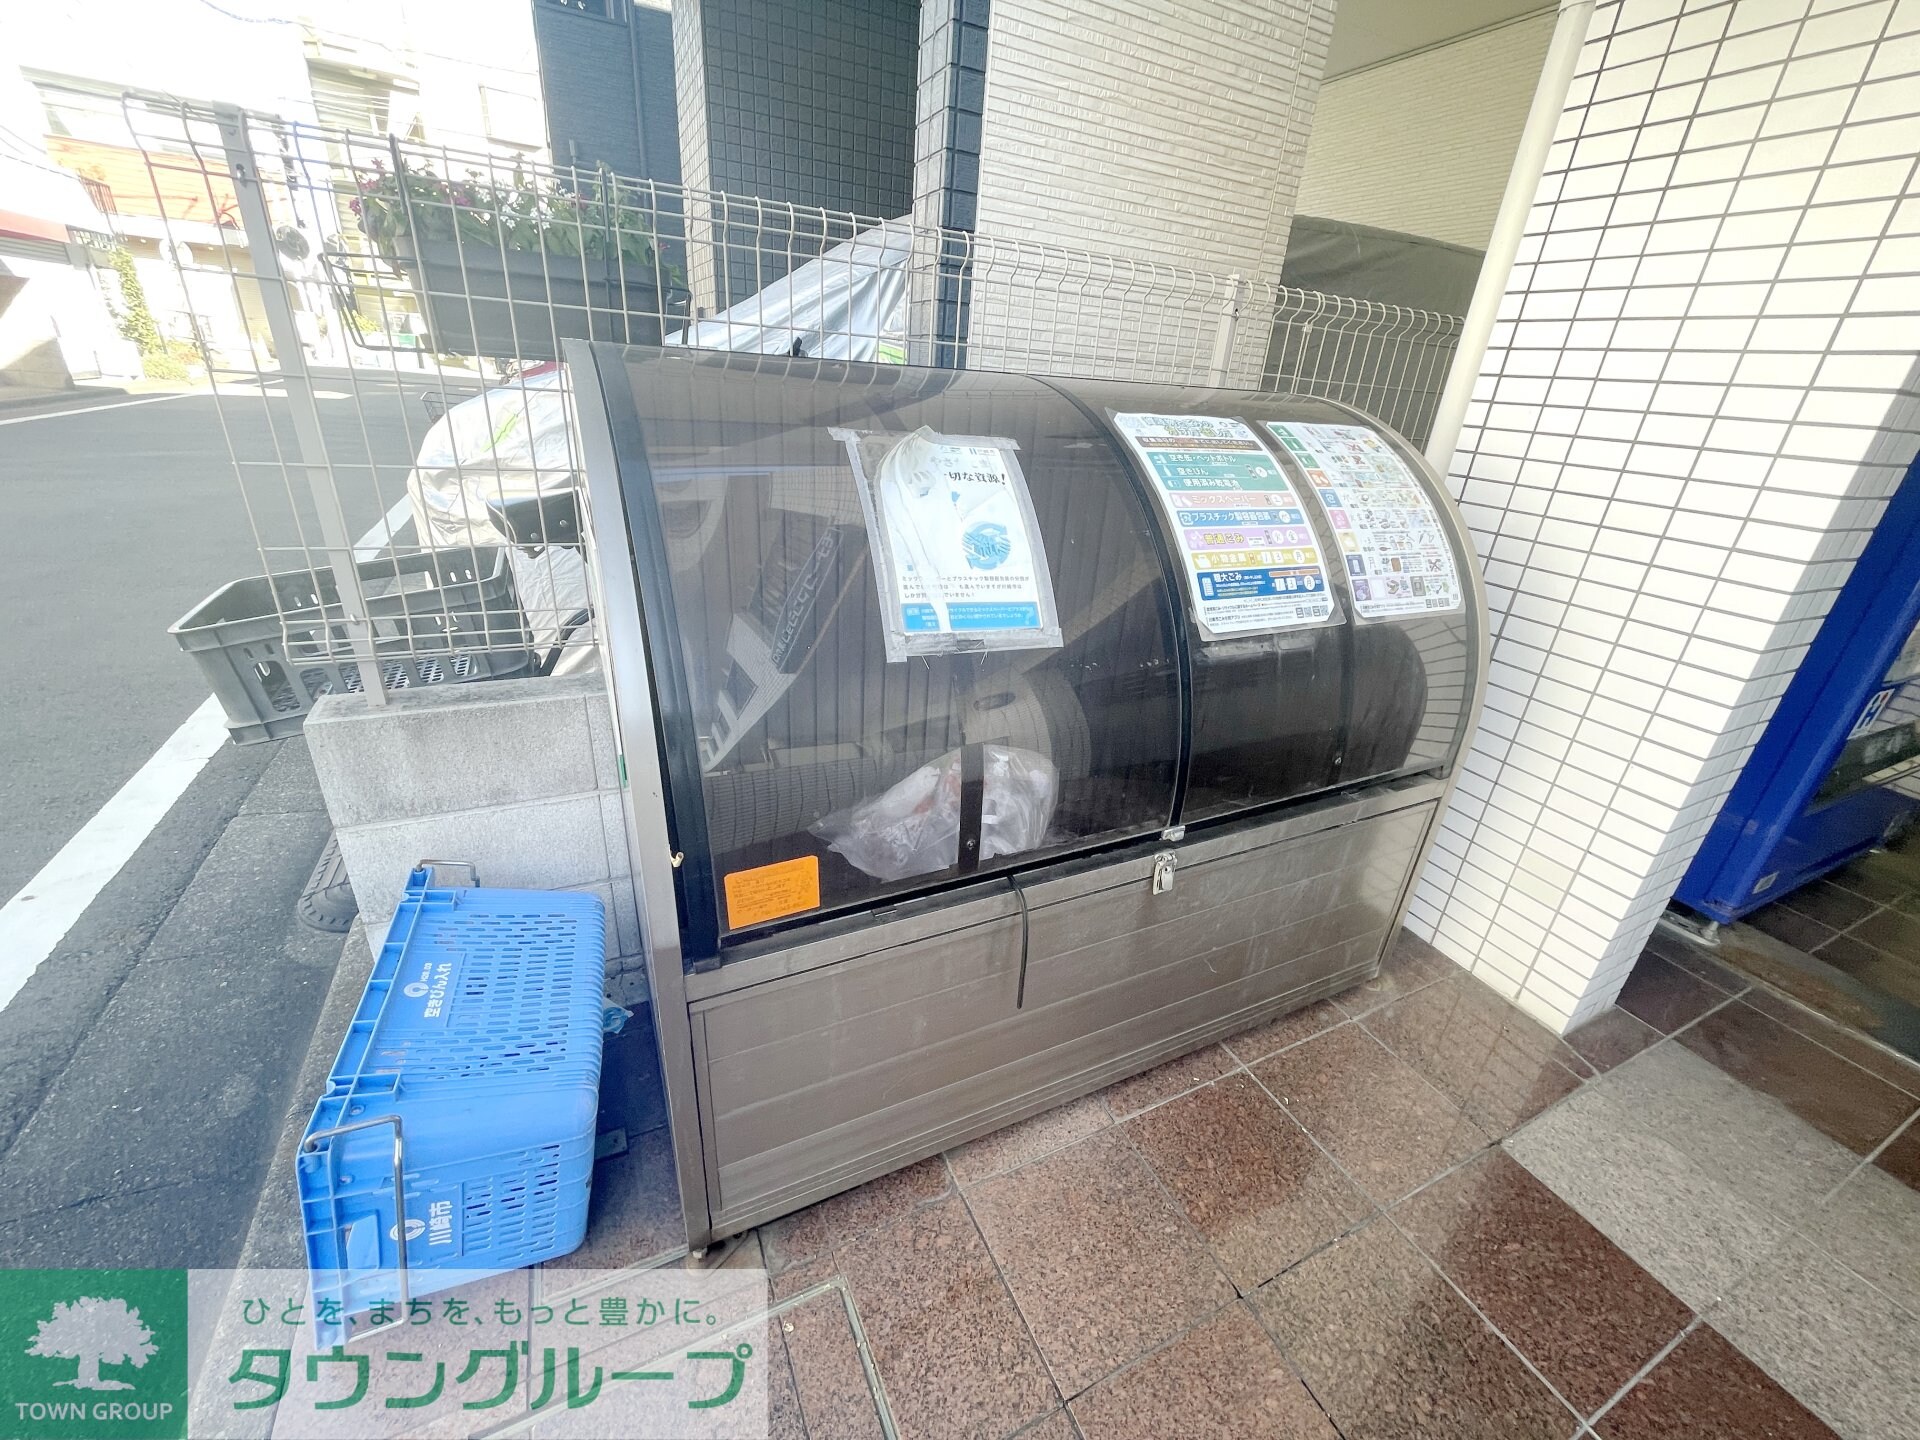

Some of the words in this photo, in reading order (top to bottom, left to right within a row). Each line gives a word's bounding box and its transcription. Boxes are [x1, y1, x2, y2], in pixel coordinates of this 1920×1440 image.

[944, 471, 1006, 485] 切な資源!
[1203, 533, 1245, 545] 普通ごみ
[423, 962, 452, 1018] 空きびん入れ
[428, 1200, 453, 1246] 川崎市
